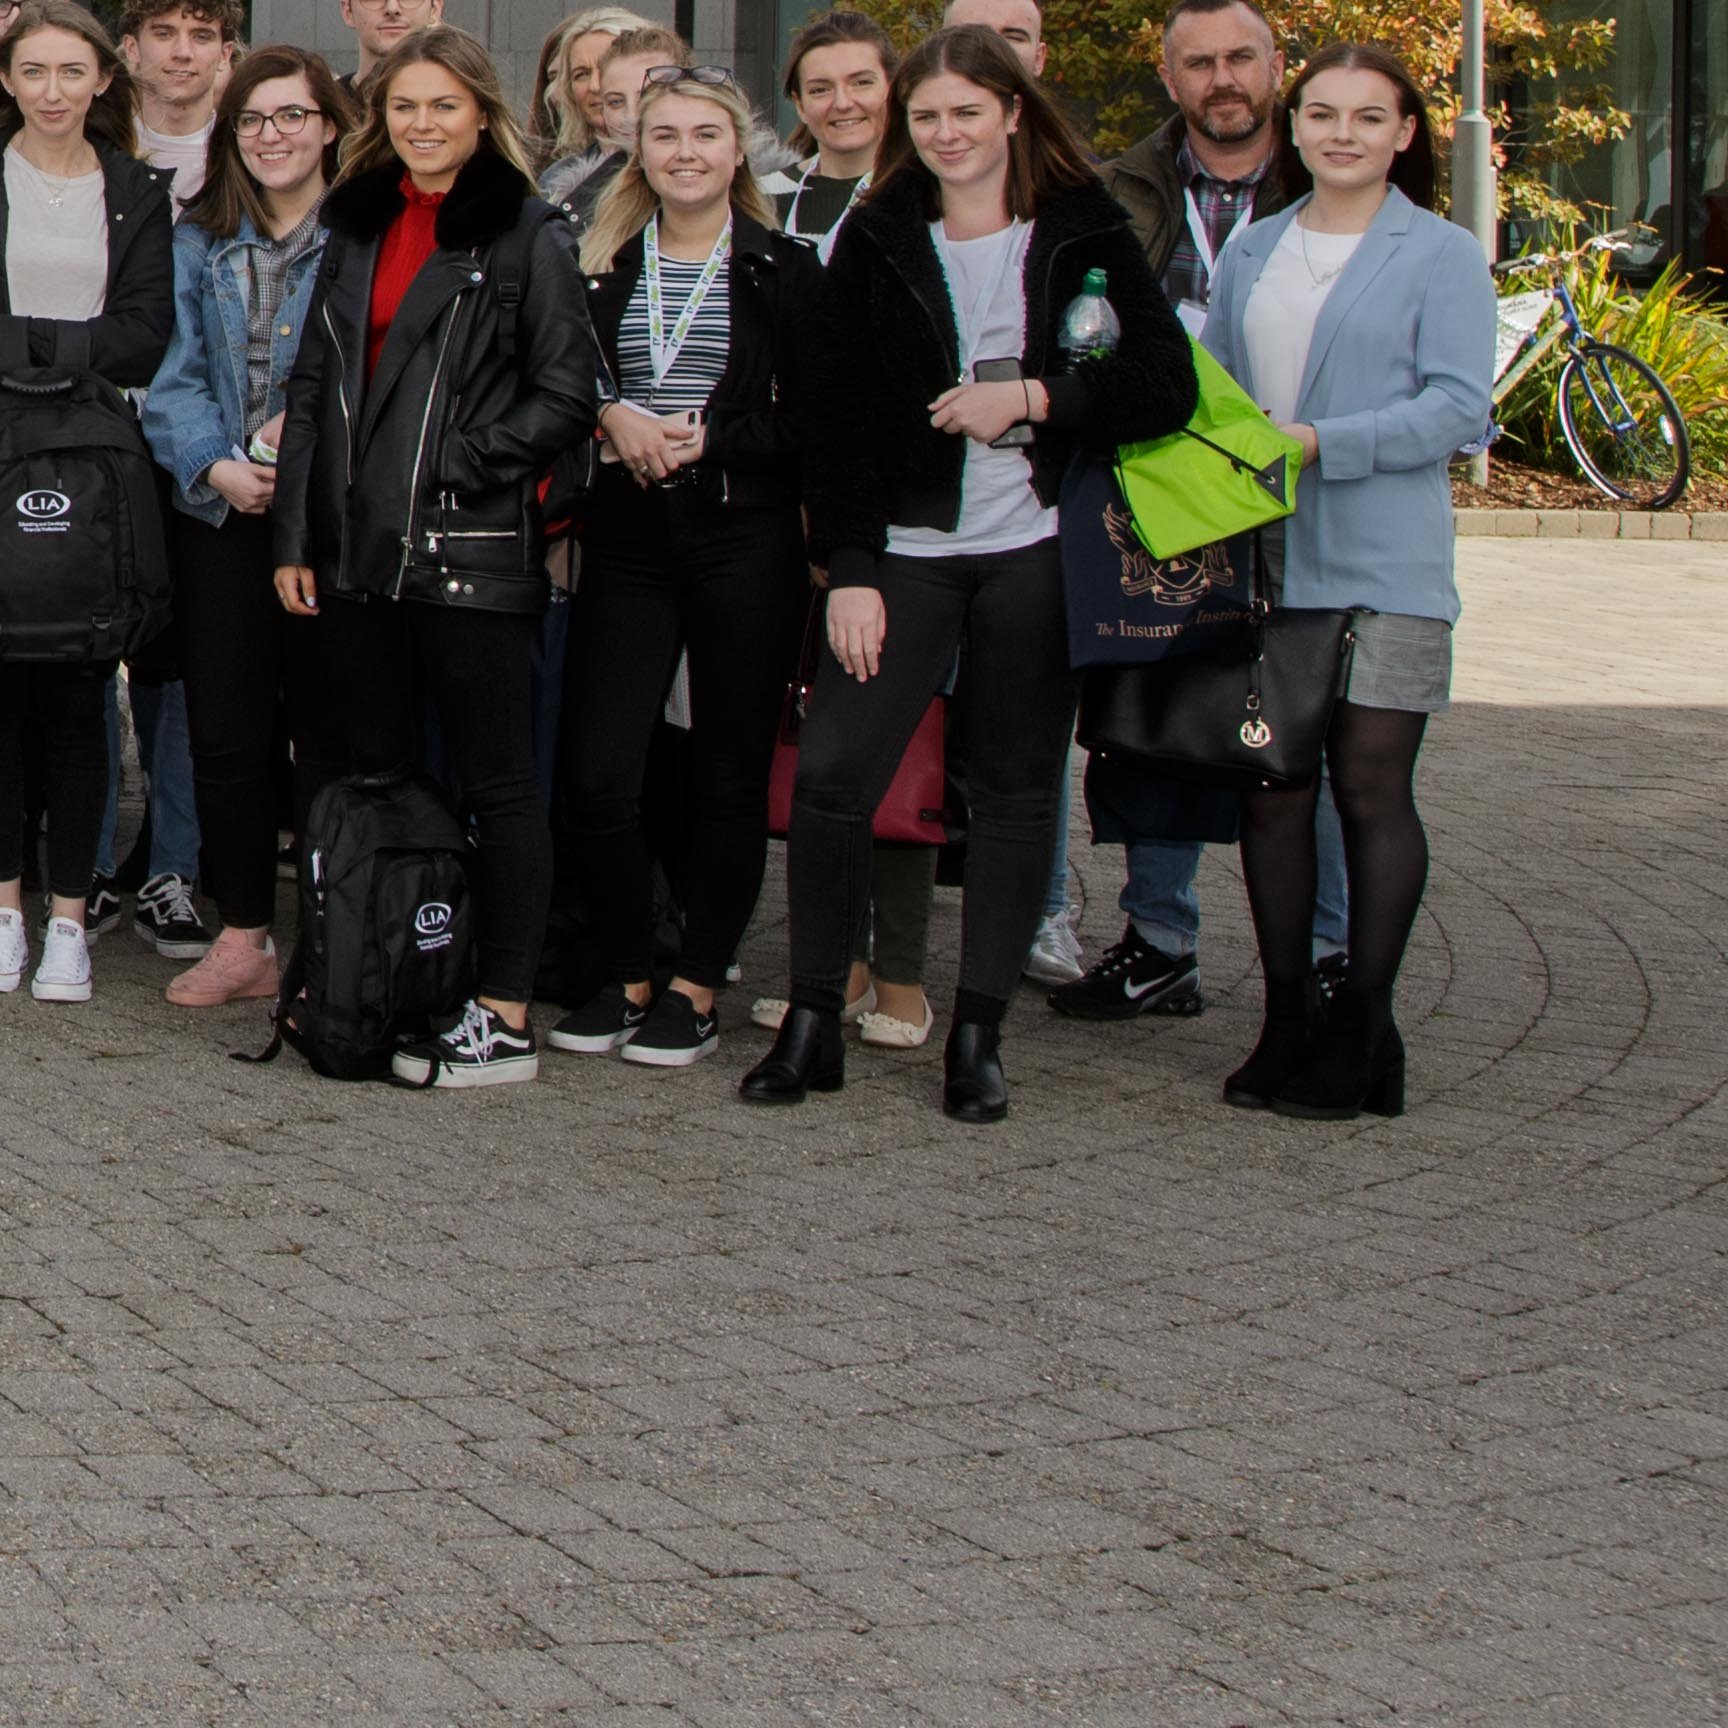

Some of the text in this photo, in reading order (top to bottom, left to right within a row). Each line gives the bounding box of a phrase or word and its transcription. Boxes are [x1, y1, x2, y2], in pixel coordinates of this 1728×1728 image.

[27, 497, 61, 511] LIA
[1096, 622, 1114, 636] The
[420, 910, 446, 927] LIA
